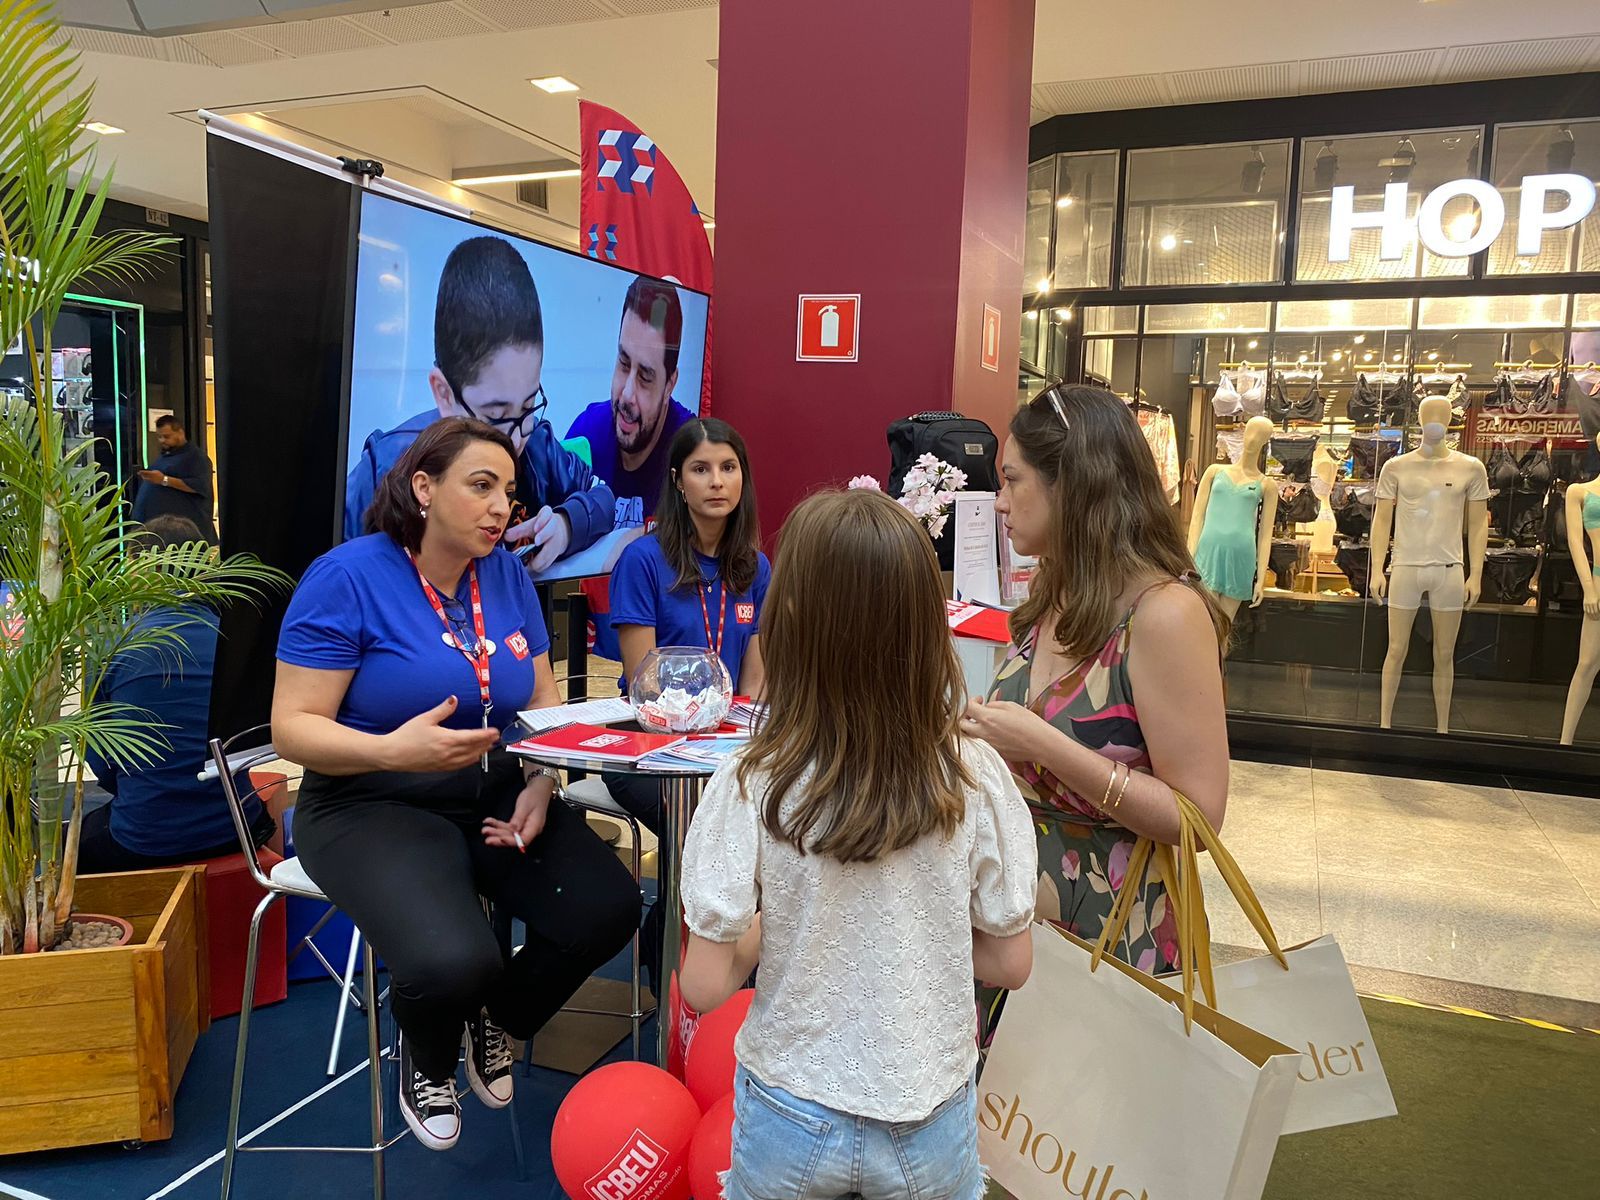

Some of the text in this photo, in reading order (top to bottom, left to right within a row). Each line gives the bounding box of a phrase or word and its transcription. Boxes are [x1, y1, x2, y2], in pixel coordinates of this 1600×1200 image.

[1328, 173, 1596, 262] HOP
[1297, 1041, 1365, 1082] der
[590, 1139, 659, 1200] ICBEU
